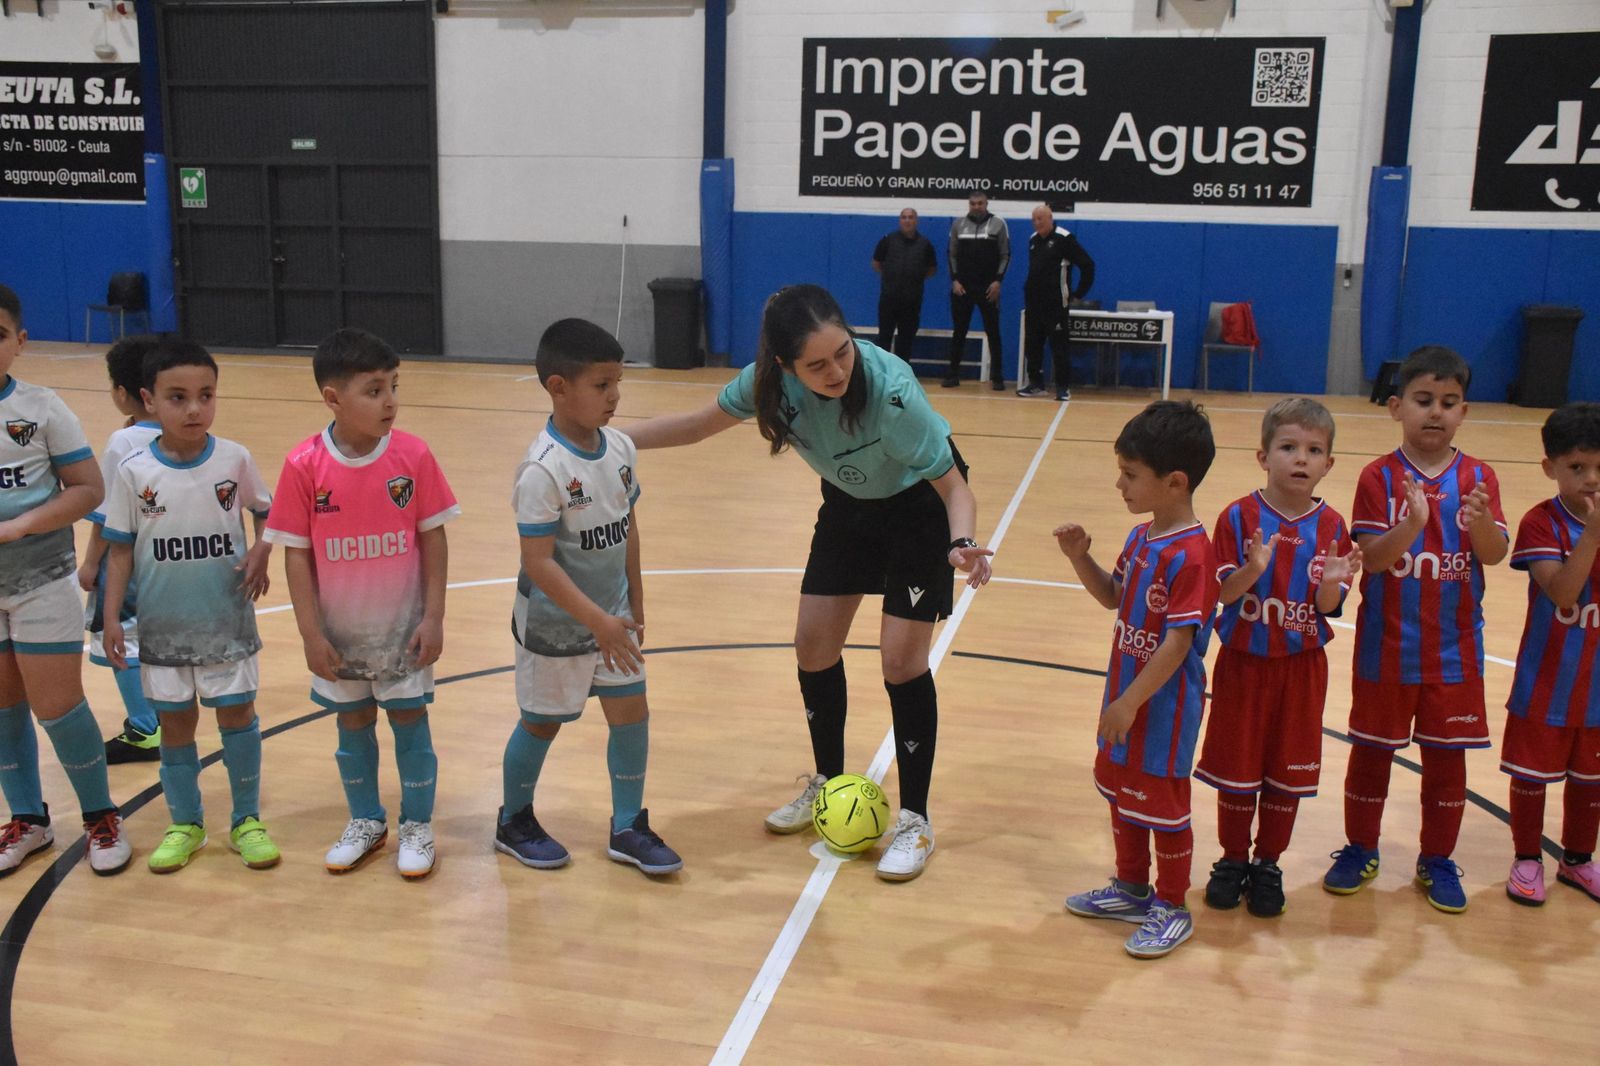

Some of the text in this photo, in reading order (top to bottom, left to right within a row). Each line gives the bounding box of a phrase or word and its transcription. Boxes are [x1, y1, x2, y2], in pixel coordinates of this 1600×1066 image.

[815, 45, 1088, 107] Imprenta
[83, 77, 141, 106] S.L.
[33, 114, 55, 131] DE
[58, 115, 145, 132] CONSTRUIR
[3, 137, 23, 152] s/n
[33, 138, 68, 153] 51002
[78, 139, 111, 153] Ceuta
[813, 109, 1307, 176] Papel de Aguas
[4, 167, 138, 186] aggroup@gmail.com
[812, 173, 874, 188] PEQUEÑO
[876, 176, 885, 188] Y
[887, 177, 925, 189] GRAN
[927, 177, 991, 190] FORMATO
[1002, 177, 1090, 193] ROTULACIÓN
[1192, 182, 1301, 200] 956 51 11 47
[1089, 319, 1139, 332] ÁRBITROS
[152, 533, 235, 563] UCIDCE
[325, 530, 409, 562] UCIDCE
[1440, 571, 1471, 583] energ
[1239, 592, 1286, 627] on
[1123, 624, 1159, 652] 365
[1284, 620, 1319, 637] energy
